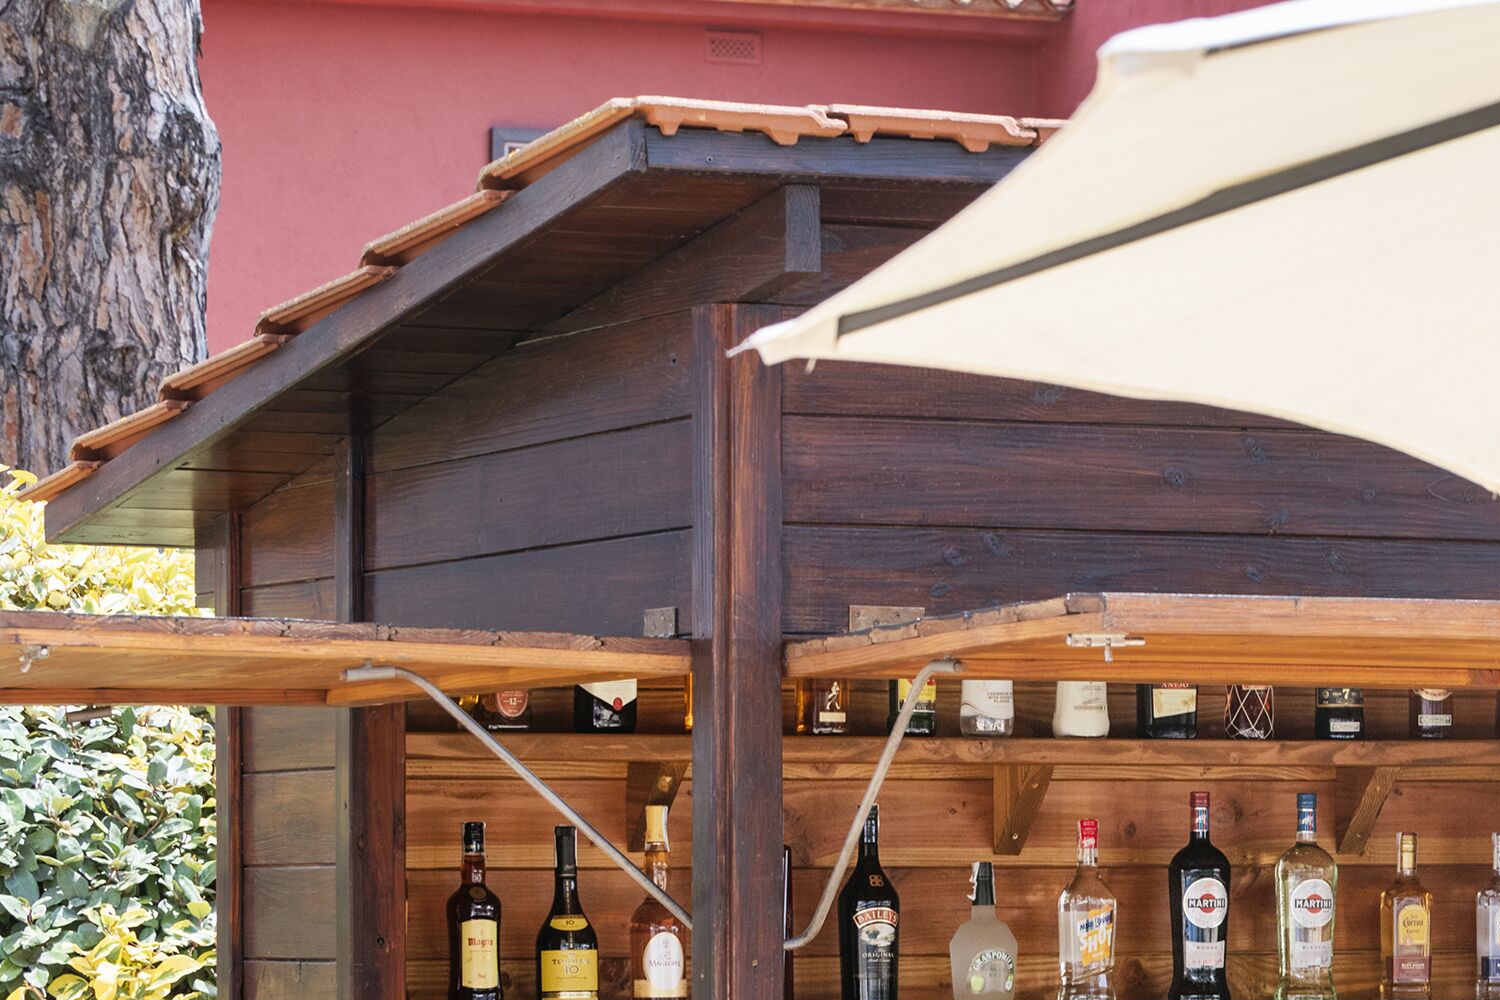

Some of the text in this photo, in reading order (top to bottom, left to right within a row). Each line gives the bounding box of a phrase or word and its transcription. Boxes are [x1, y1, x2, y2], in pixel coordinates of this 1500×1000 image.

[1342, 688, 1350, 700] 7
[508, 697, 517, 706] 12
[1187, 898, 1226, 909] MARTINI
[1294, 899, 1332, 909] MARTINI
[857, 909, 898, 923] BAILEYS
[1080, 925, 1113, 953] SHOT
[563, 965, 579, 975] 10
